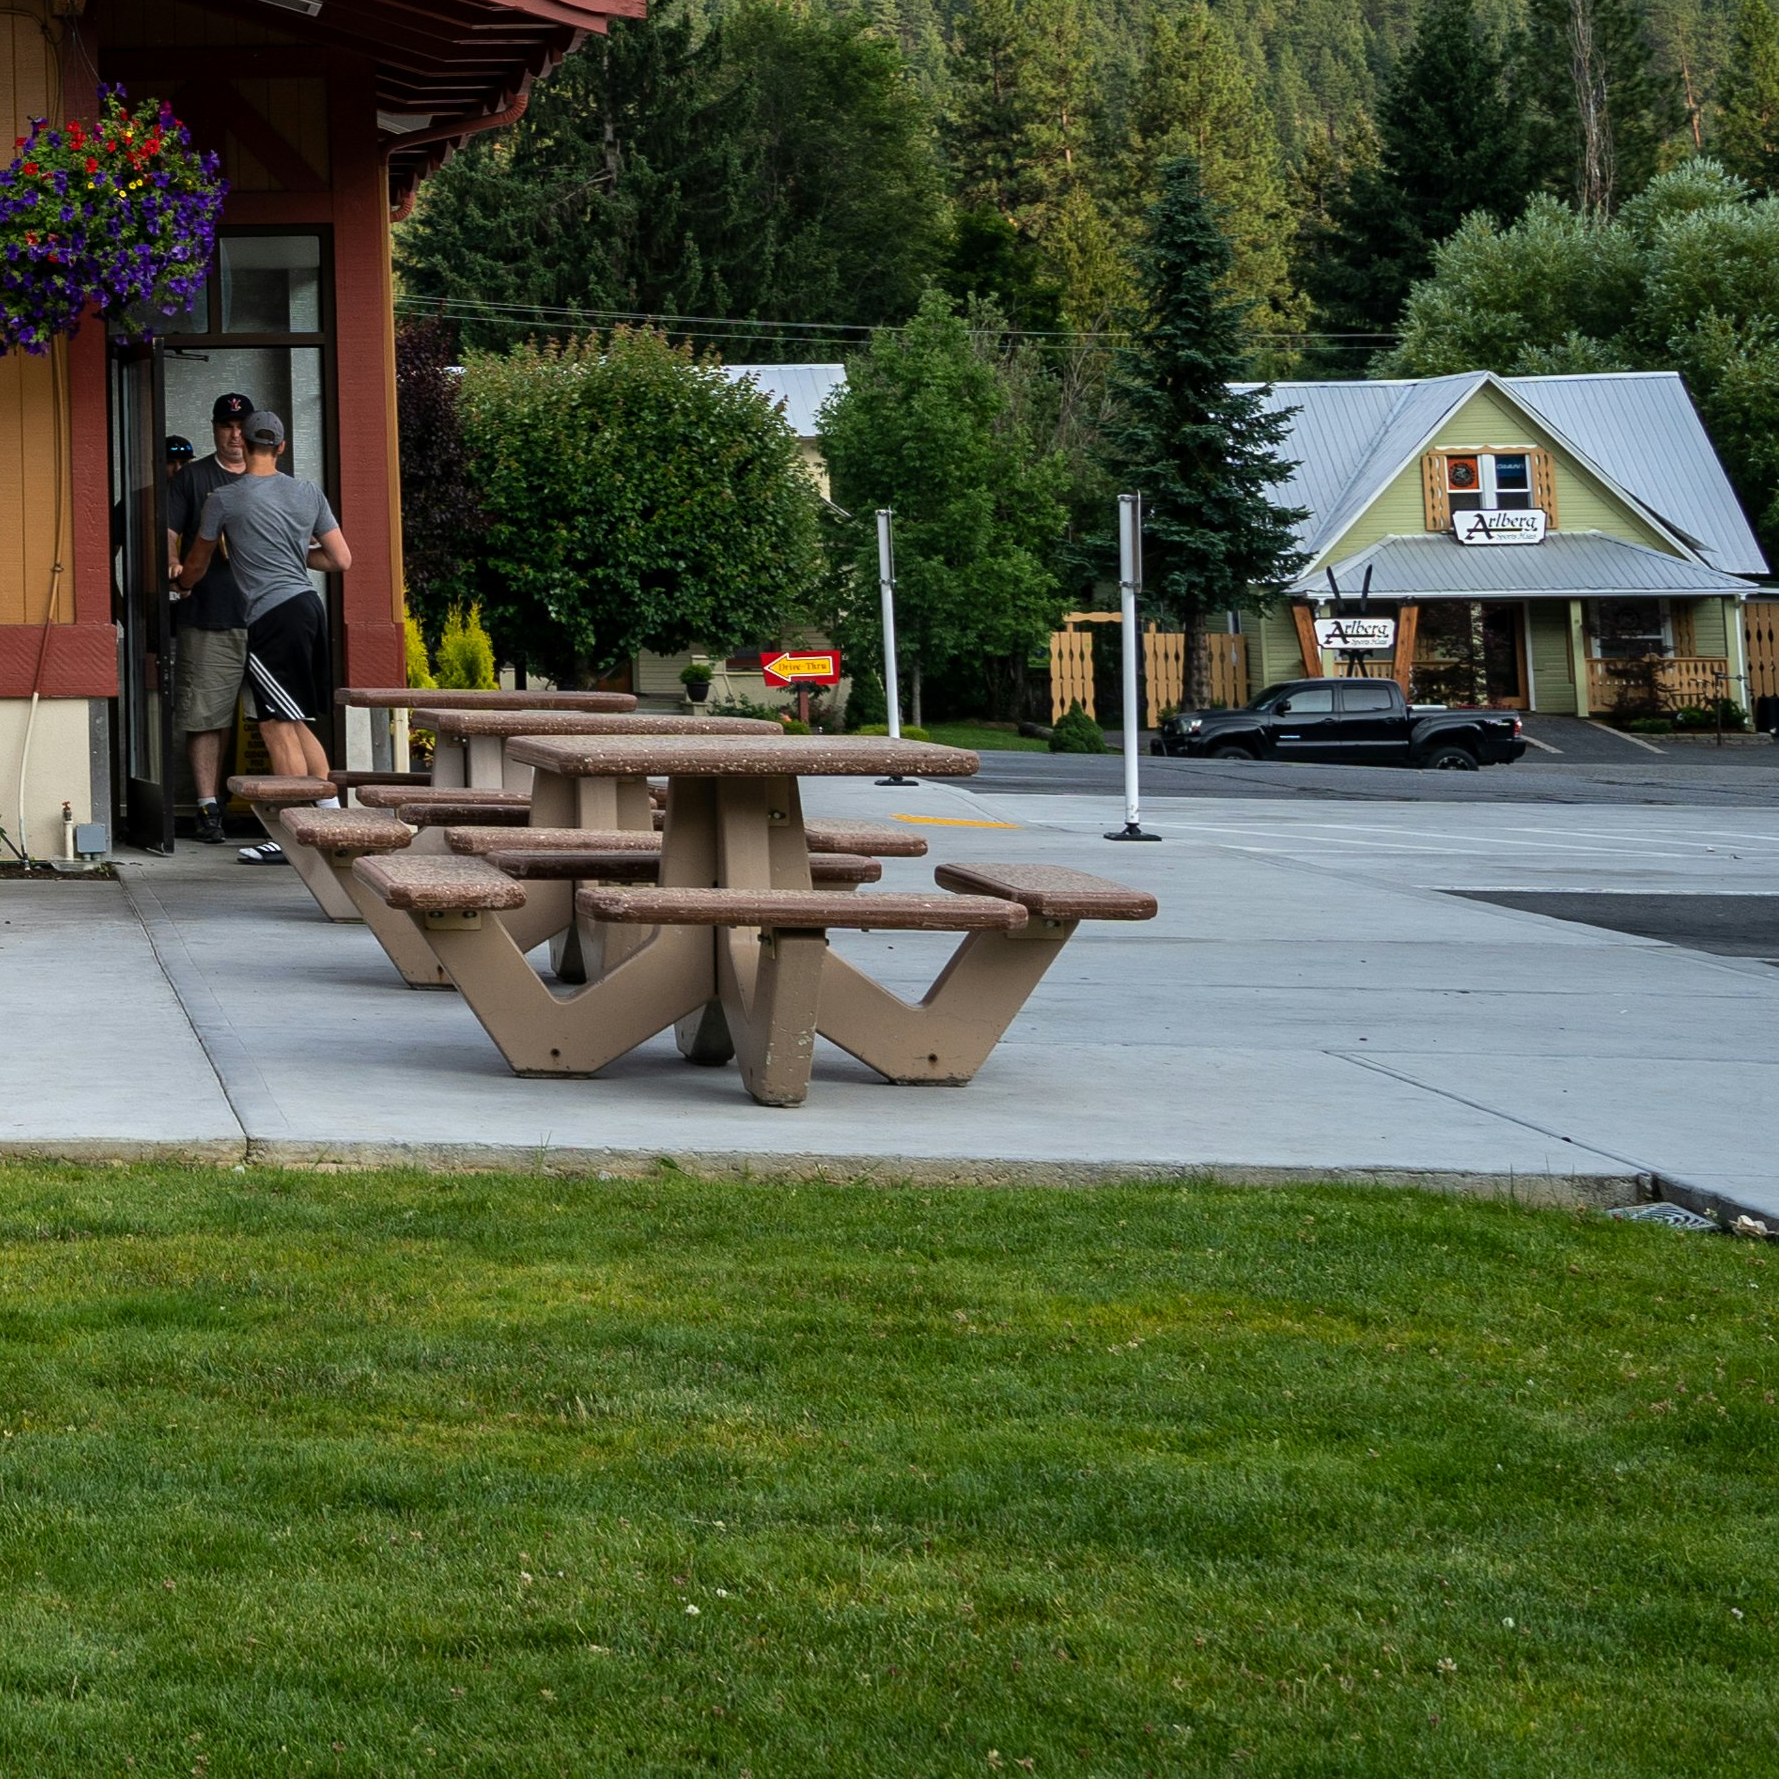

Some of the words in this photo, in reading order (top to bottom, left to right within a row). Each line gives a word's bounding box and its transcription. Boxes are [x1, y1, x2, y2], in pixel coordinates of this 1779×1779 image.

[1464, 512, 1538, 540] Arlberg
[1323, 620, 1389, 644] Arlberg
[778, 662, 827, 671] Drive-Thru
